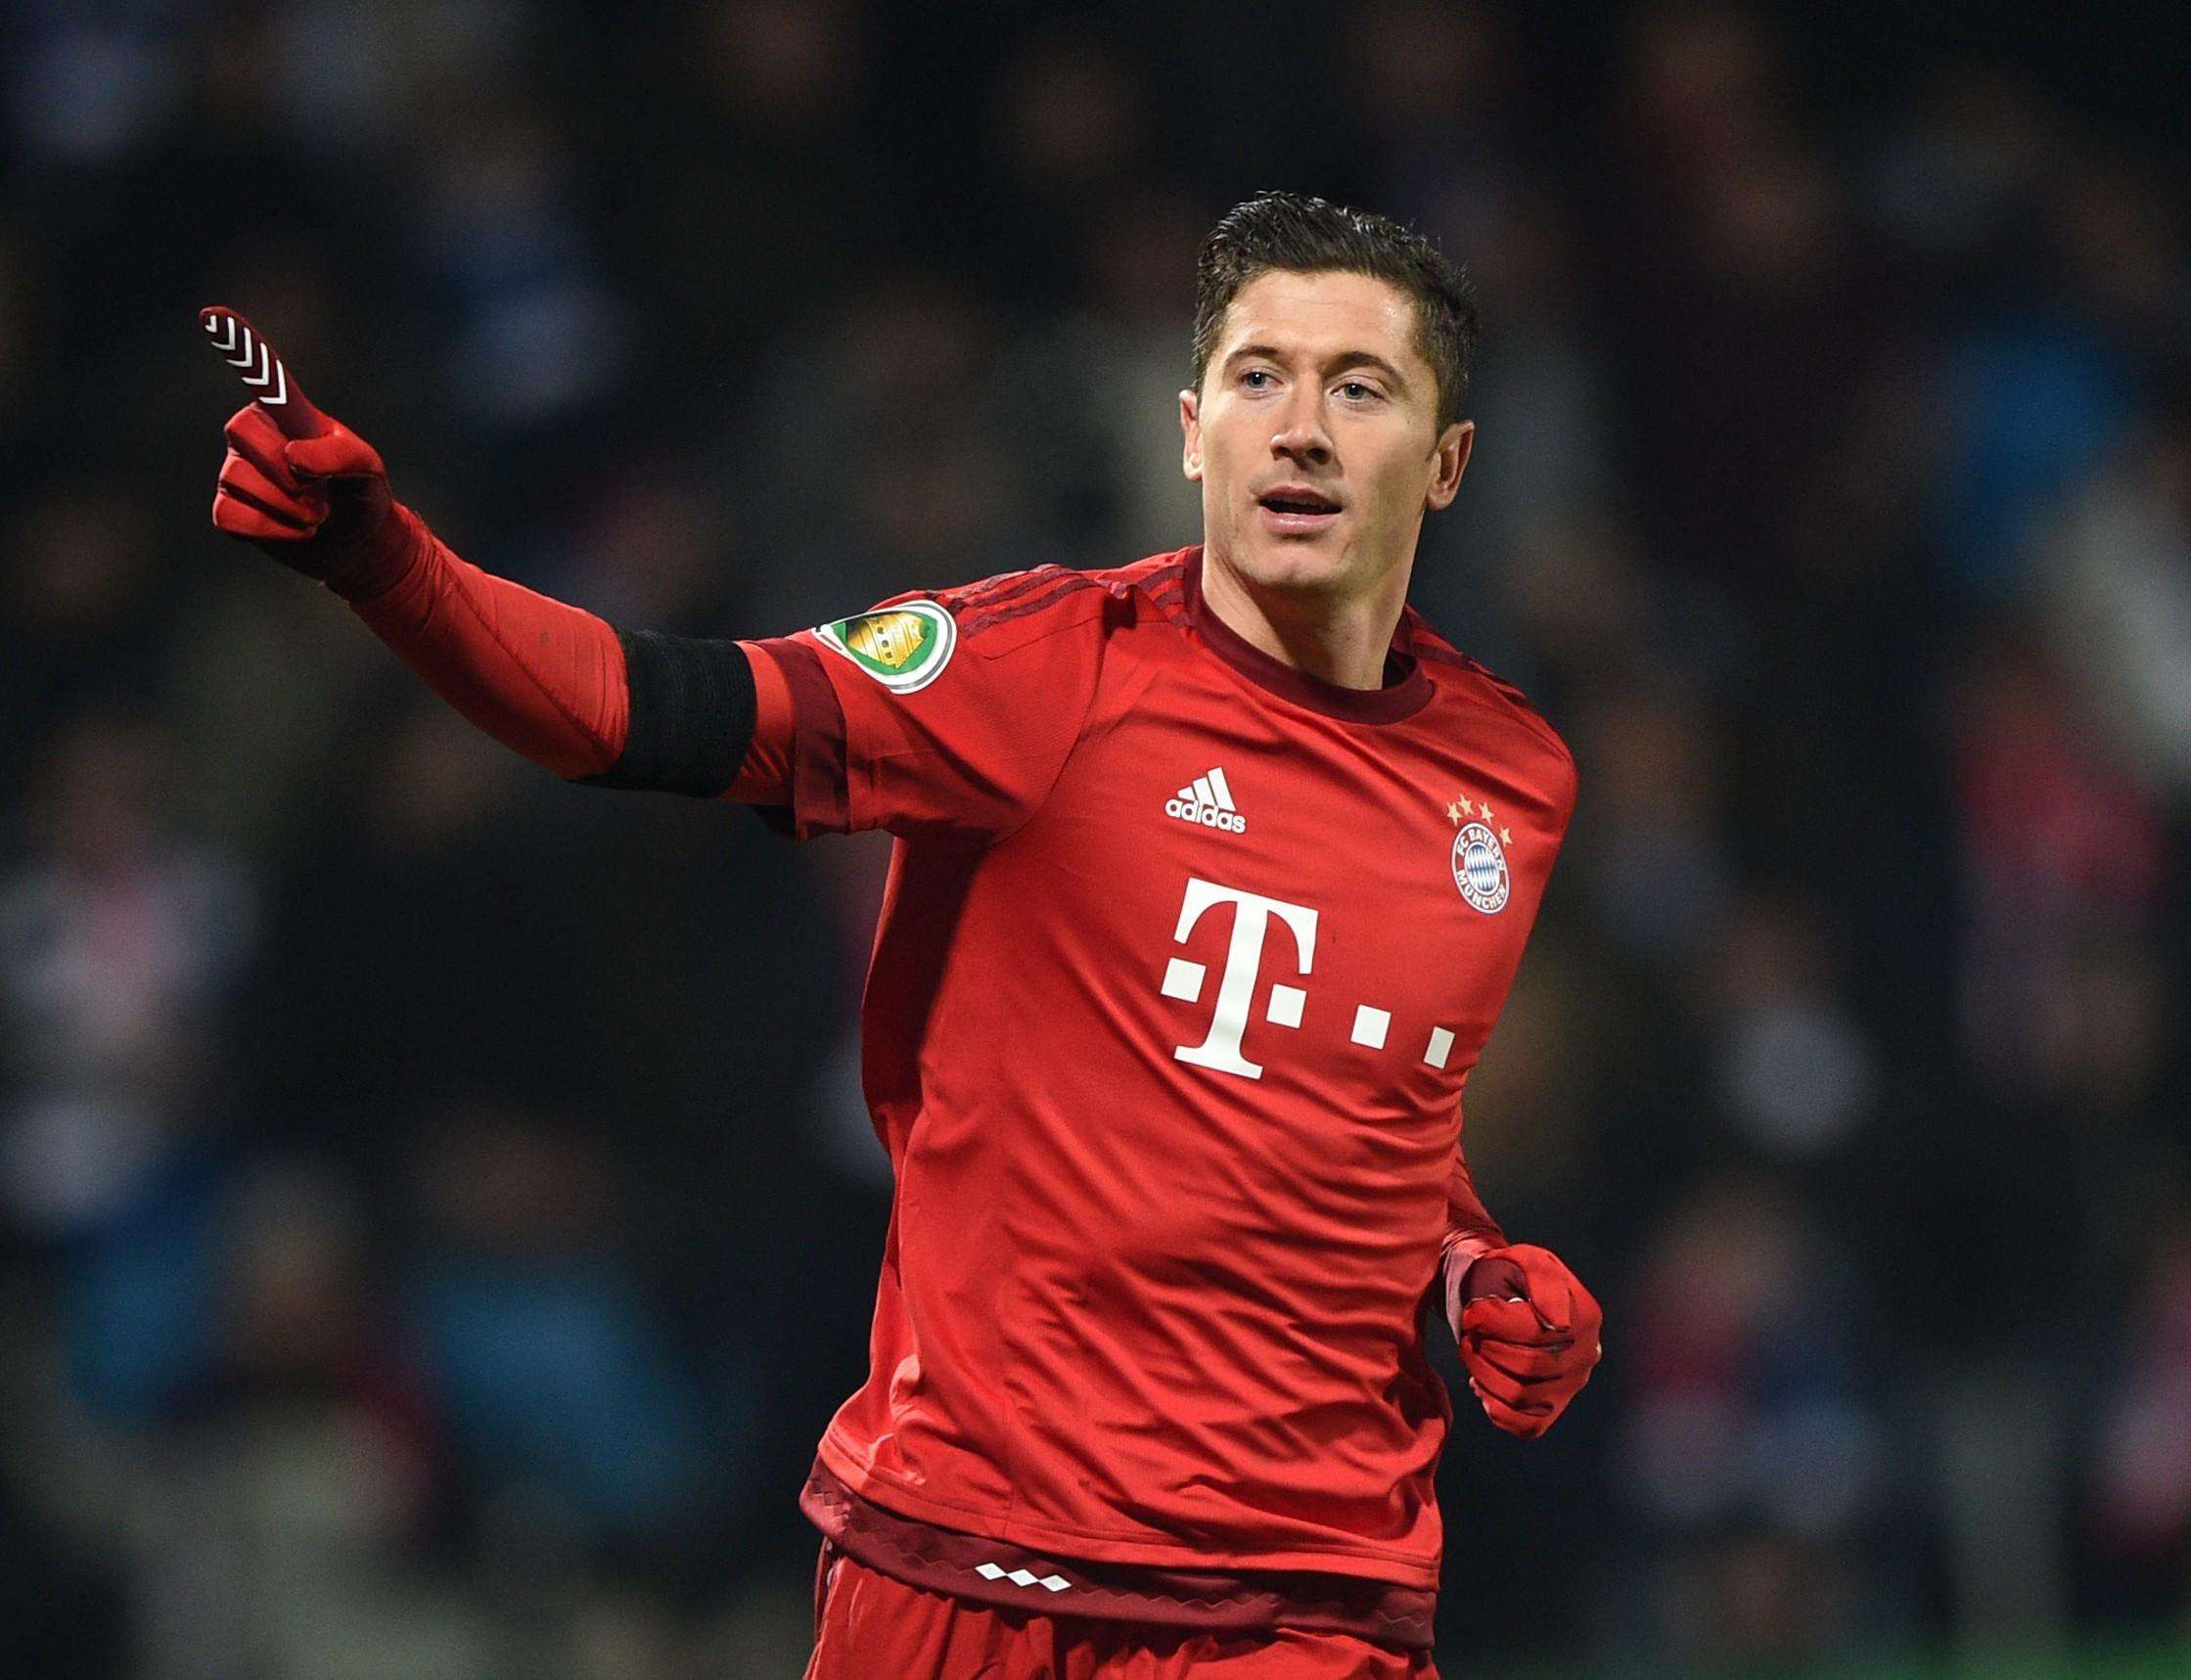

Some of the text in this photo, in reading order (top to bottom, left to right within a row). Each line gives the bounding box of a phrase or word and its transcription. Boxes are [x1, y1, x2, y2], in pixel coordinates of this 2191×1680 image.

[1164, 798, 1247, 834] adidas
[1456, 829, 1505, 871] FC BAYERN
